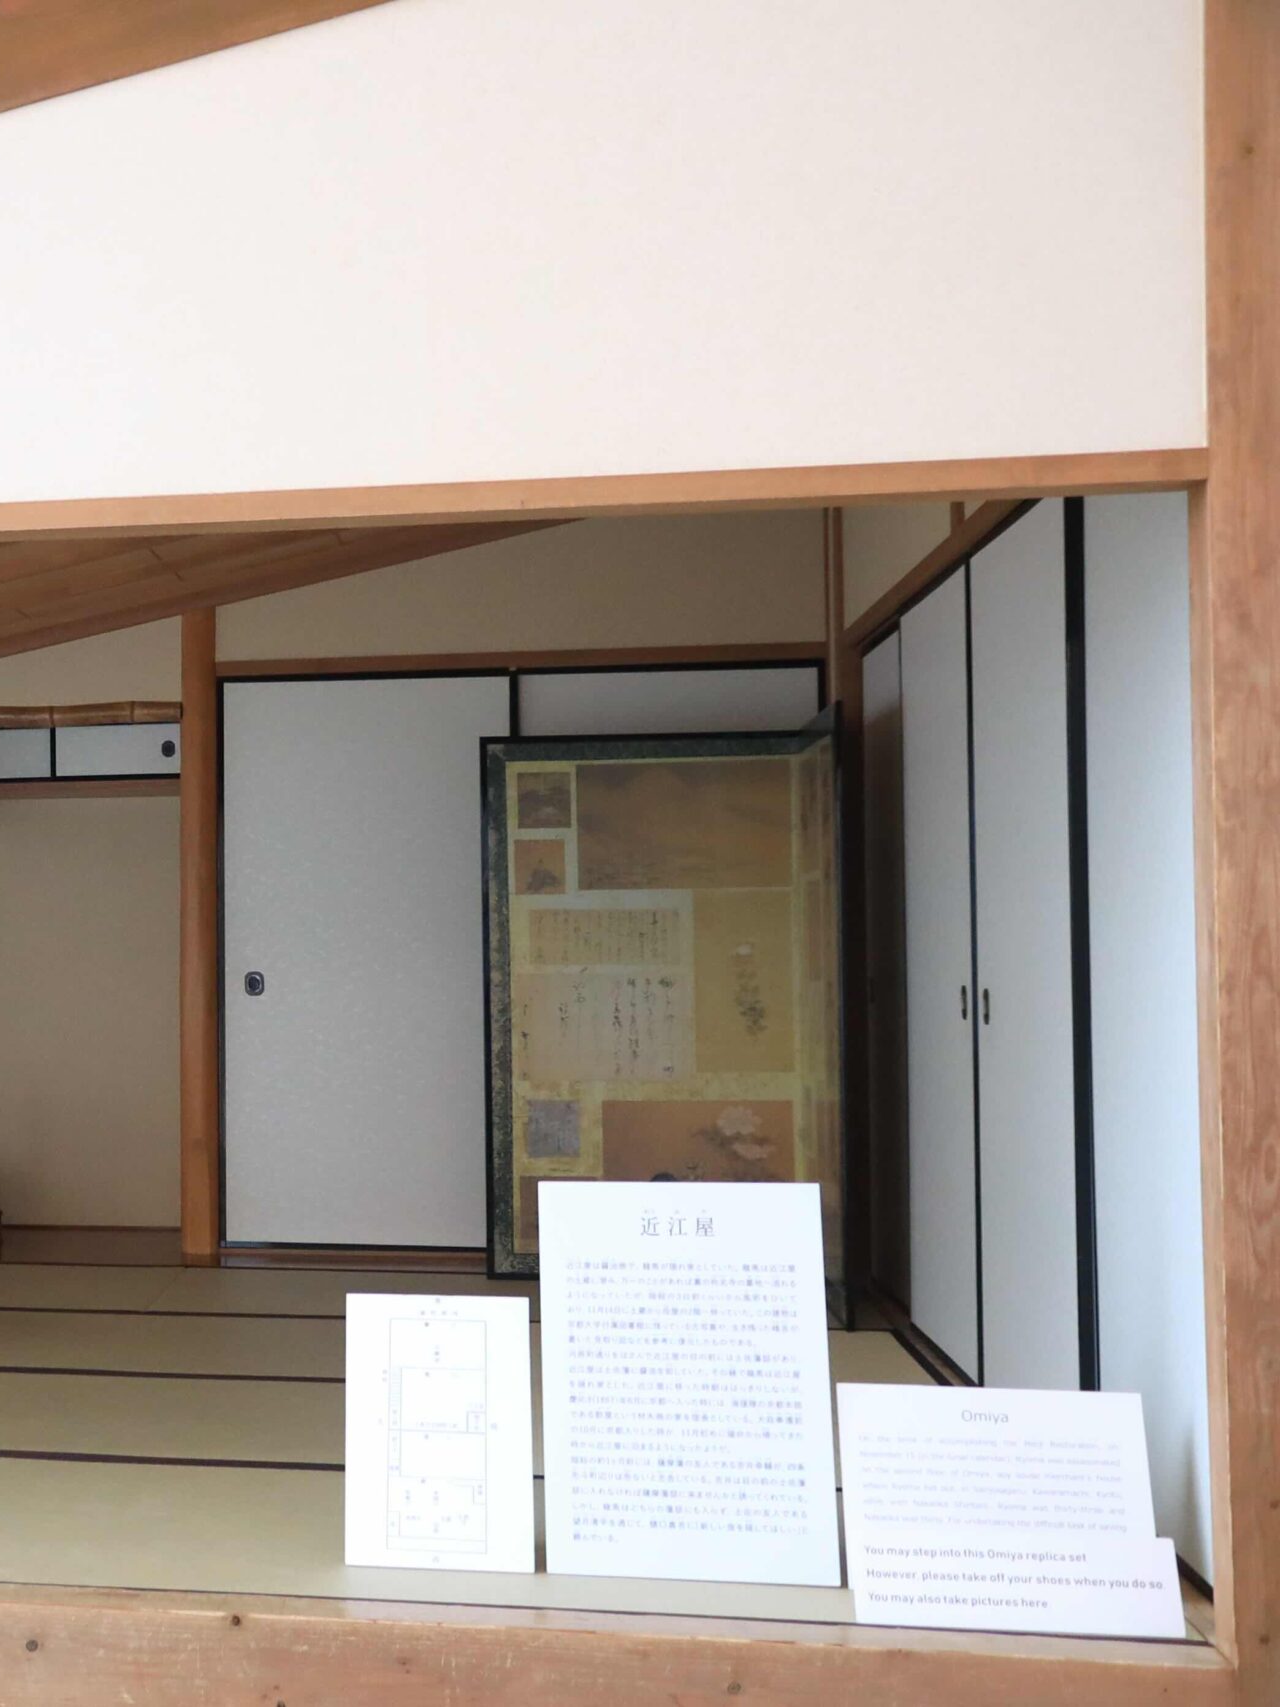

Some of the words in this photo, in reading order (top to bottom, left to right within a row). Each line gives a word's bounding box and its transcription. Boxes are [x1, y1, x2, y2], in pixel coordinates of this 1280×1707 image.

[640, 1216, 715, 1237] 近江屋
[961, 1409, 1009, 1425] Omiya
[864, 1545, 884, 1555] You
[887, 1547, 910, 1558] may
[912, 1547, 937, 1559] step
[939, 1547, 961, 1558] into
[963, 1548, 985, 1559] this
[987, 1549, 1023, 1562] Omiya
[1025, 1551, 1066, 1563] replica
[921, 1570, 959, 1582] please
[962, 1571, 987, 1582] take
[989, 1572, 1005, 1583] off
[1007, 1575, 1032, 1586] your
[1035, 1575, 1071, 1586] shoes
[1073, 1576, 1106, 1587] when
[1108, 1579, 1130, 1590] you
[1131, 1578, 1146, 1588] do
[868, 1591, 888, 1601] You
[890, 1594, 914, 1605] may
[917, 1593, 941, 1604] also
[943, 1595, 969, 1605] take
[971, 1596, 1019, 1608] pictures
